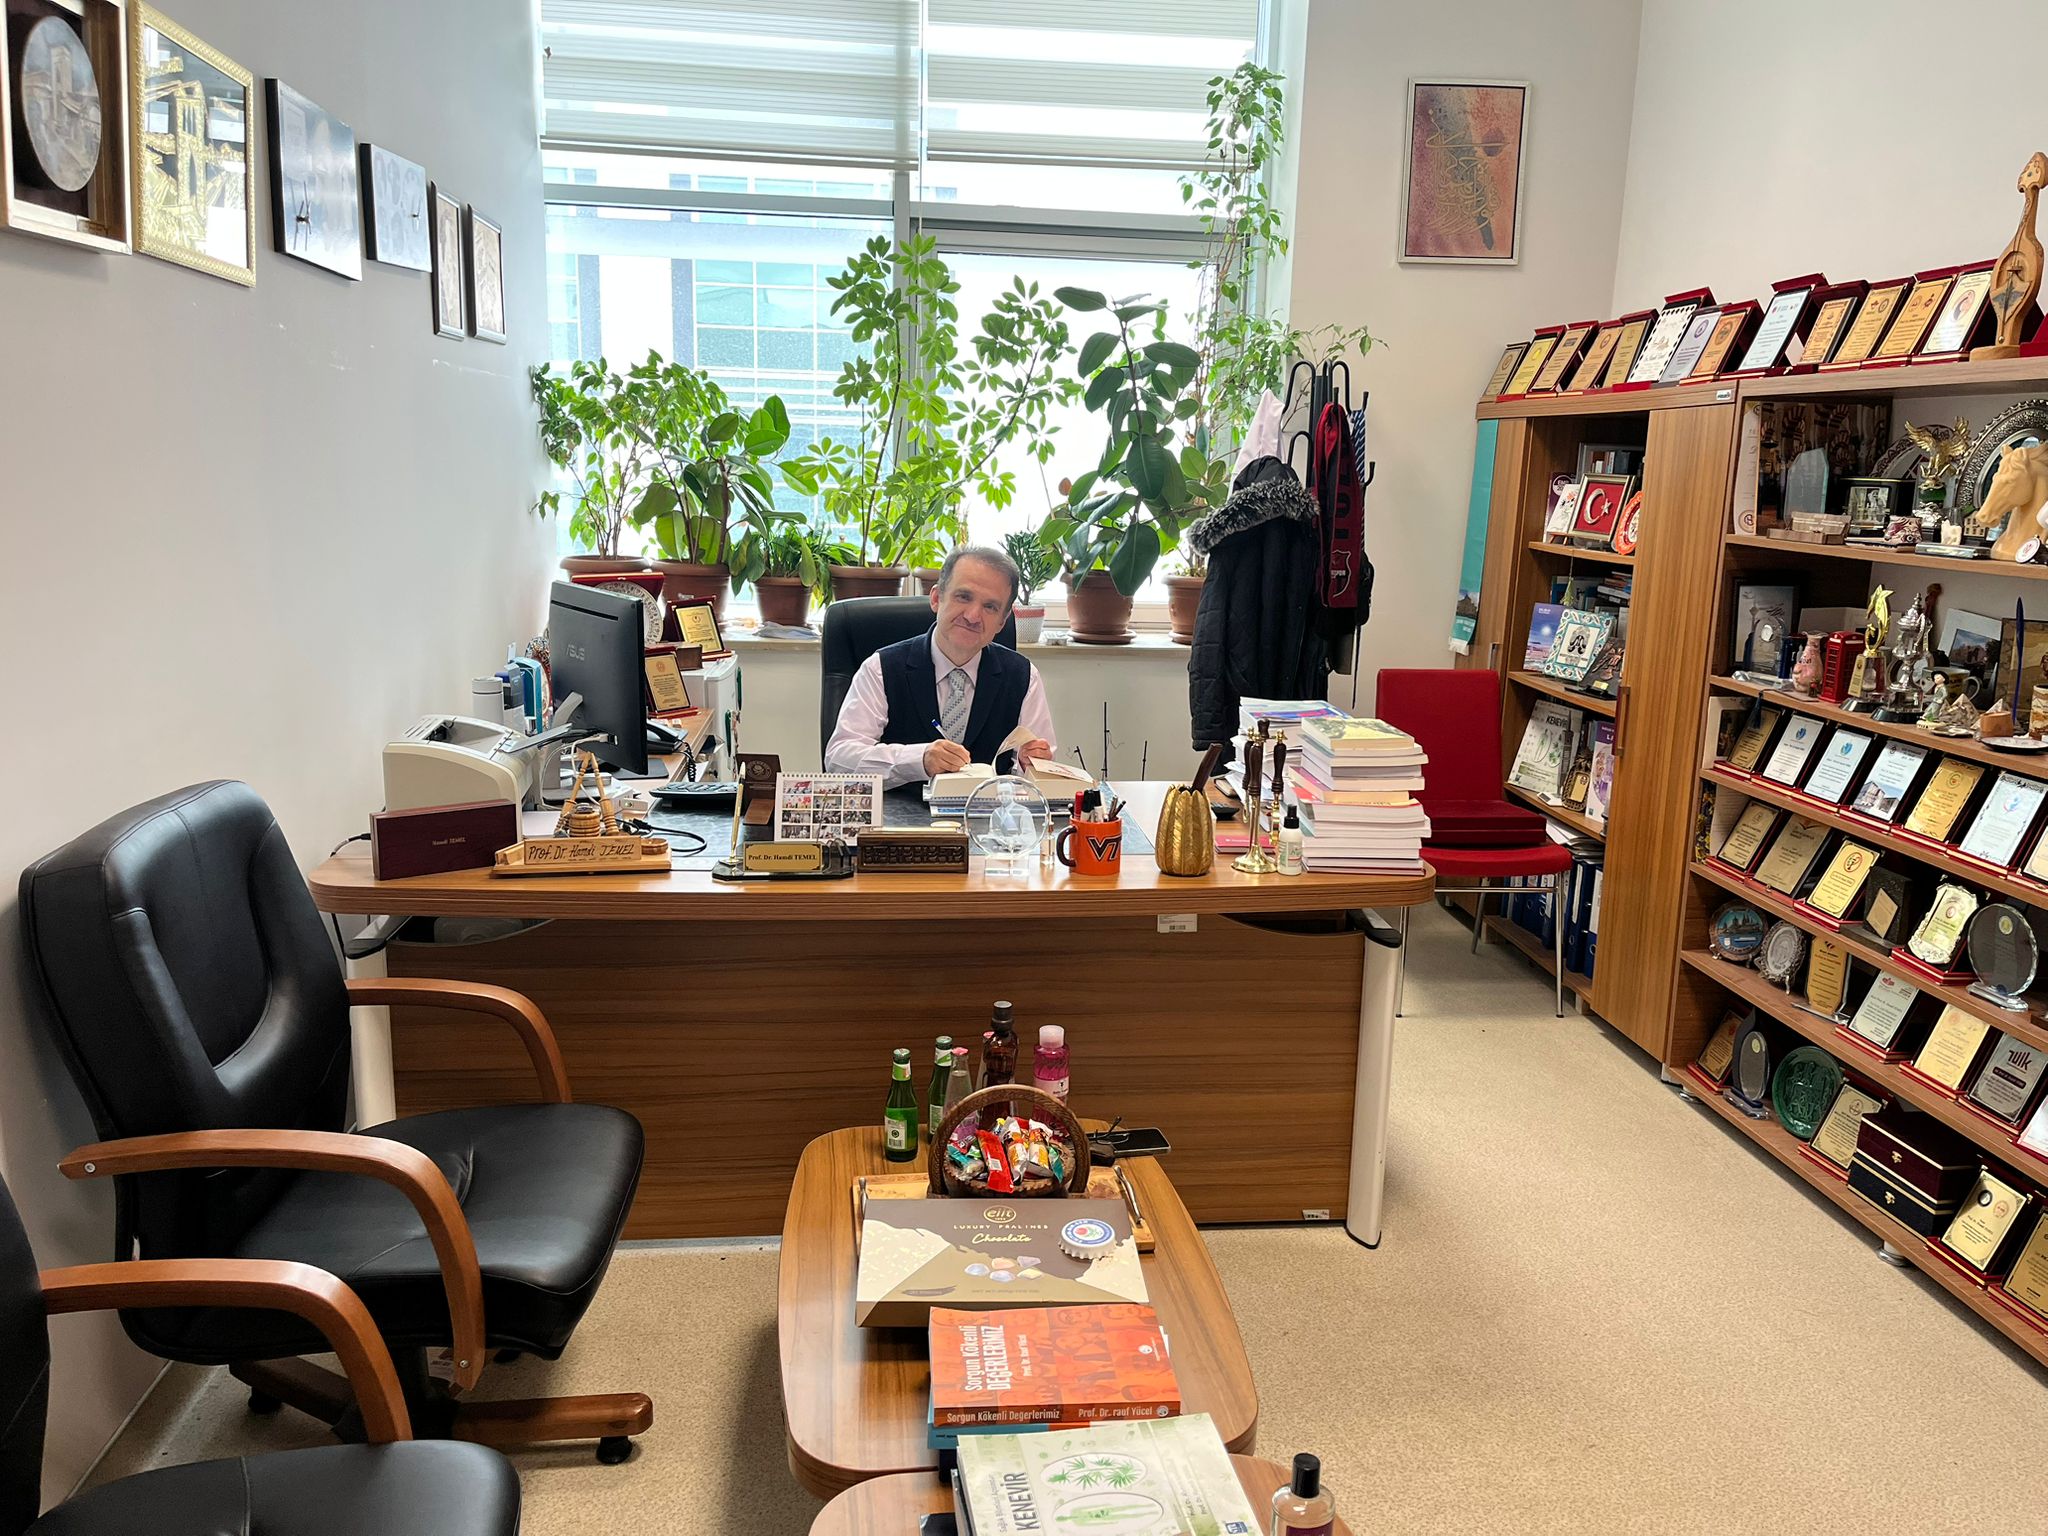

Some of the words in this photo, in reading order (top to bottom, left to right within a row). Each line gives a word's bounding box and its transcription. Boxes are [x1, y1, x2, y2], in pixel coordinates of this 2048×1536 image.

[528, 844, 552, 860] Prof.
[553, 845, 566, 859] Dr.
[568, 845, 595, 858] Hamdi
[748, 854, 762, 862] Prof.
[972, 1232, 1032, 1244] Chocolate
[958, 1325, 979, 1358] Kökenli
[965, 1360, 985, 1391] Sorgun
[947, 1411, 976, 1424] Sorgun
[977, 1410, 1007, 1422] Kökenli
[1078, 1408, 1098, 1418] Prof.
[1130, 1405, 1153, 1416] Yücel
[1001, 1471, 1041, 1531] KENEVİR
